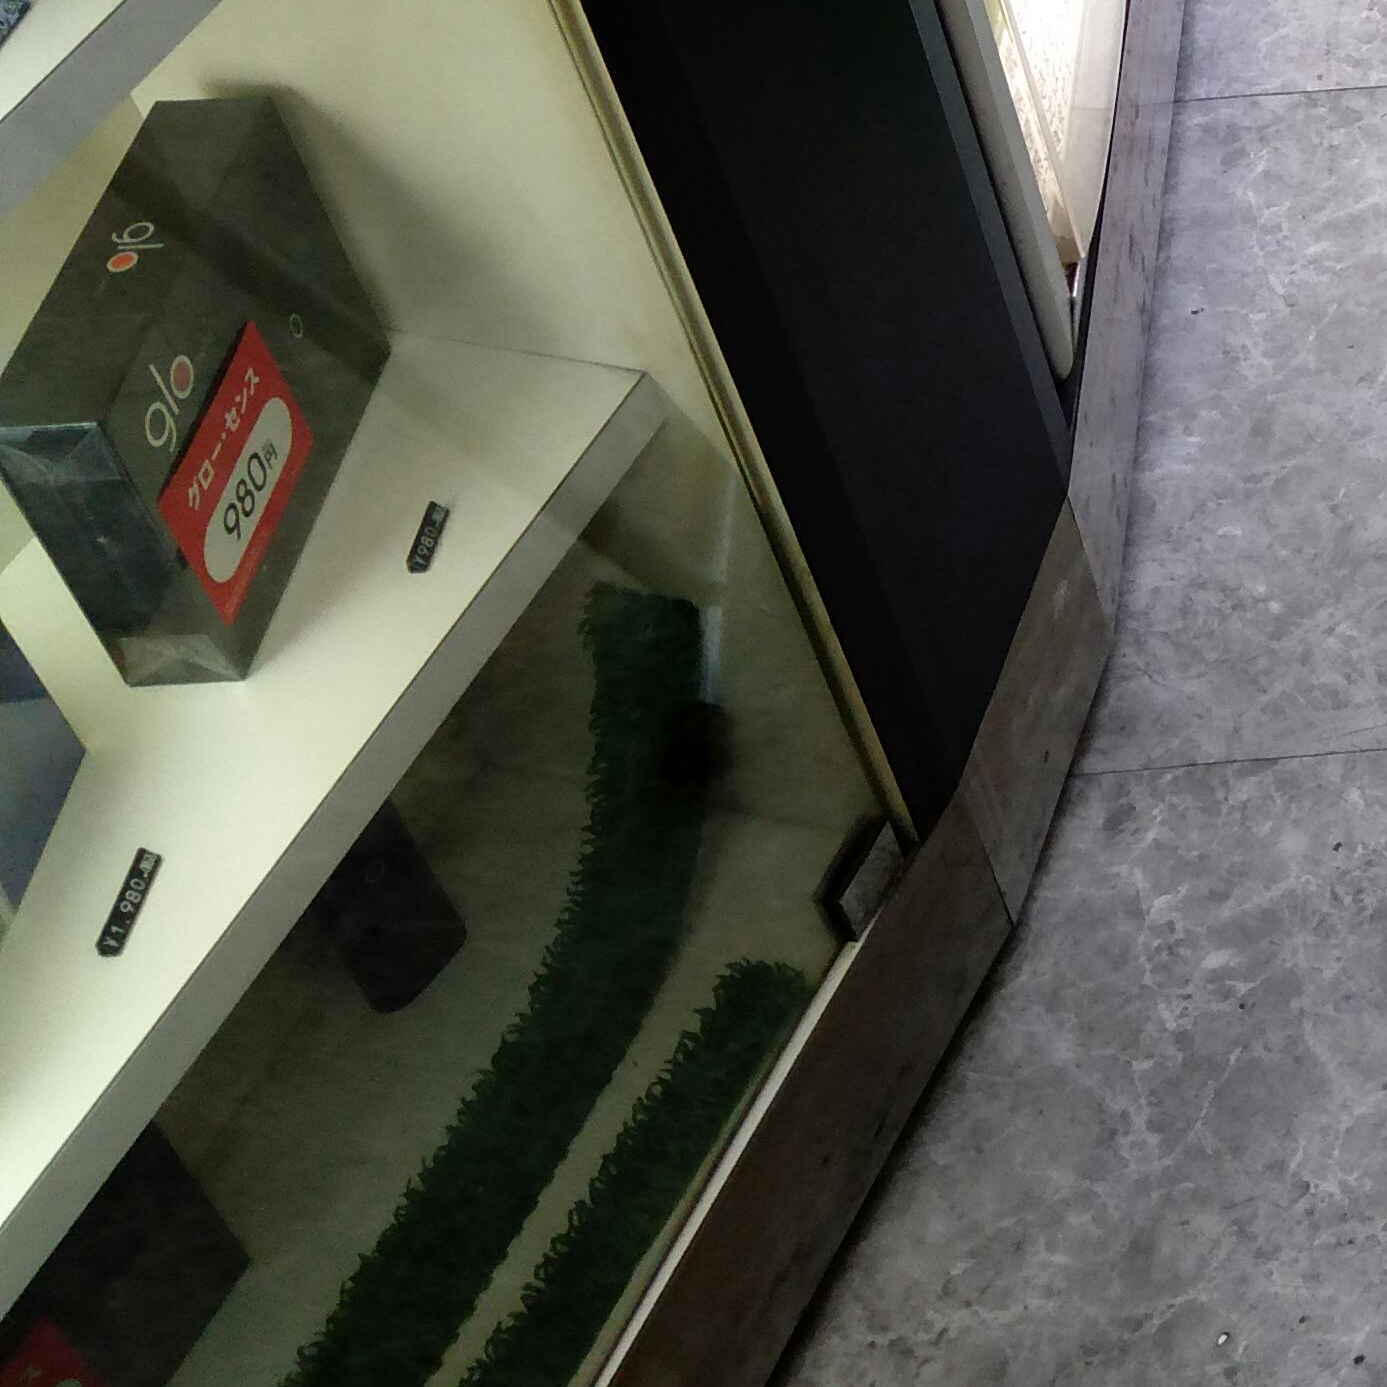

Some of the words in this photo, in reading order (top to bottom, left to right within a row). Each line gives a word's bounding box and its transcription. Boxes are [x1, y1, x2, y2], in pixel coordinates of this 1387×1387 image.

[107, 221, 165, 272] glo
[145, 354, 194, 453] glo
[188, 366, 261, 511] グロー・センス
[222, 438, 279, 542] 980円
